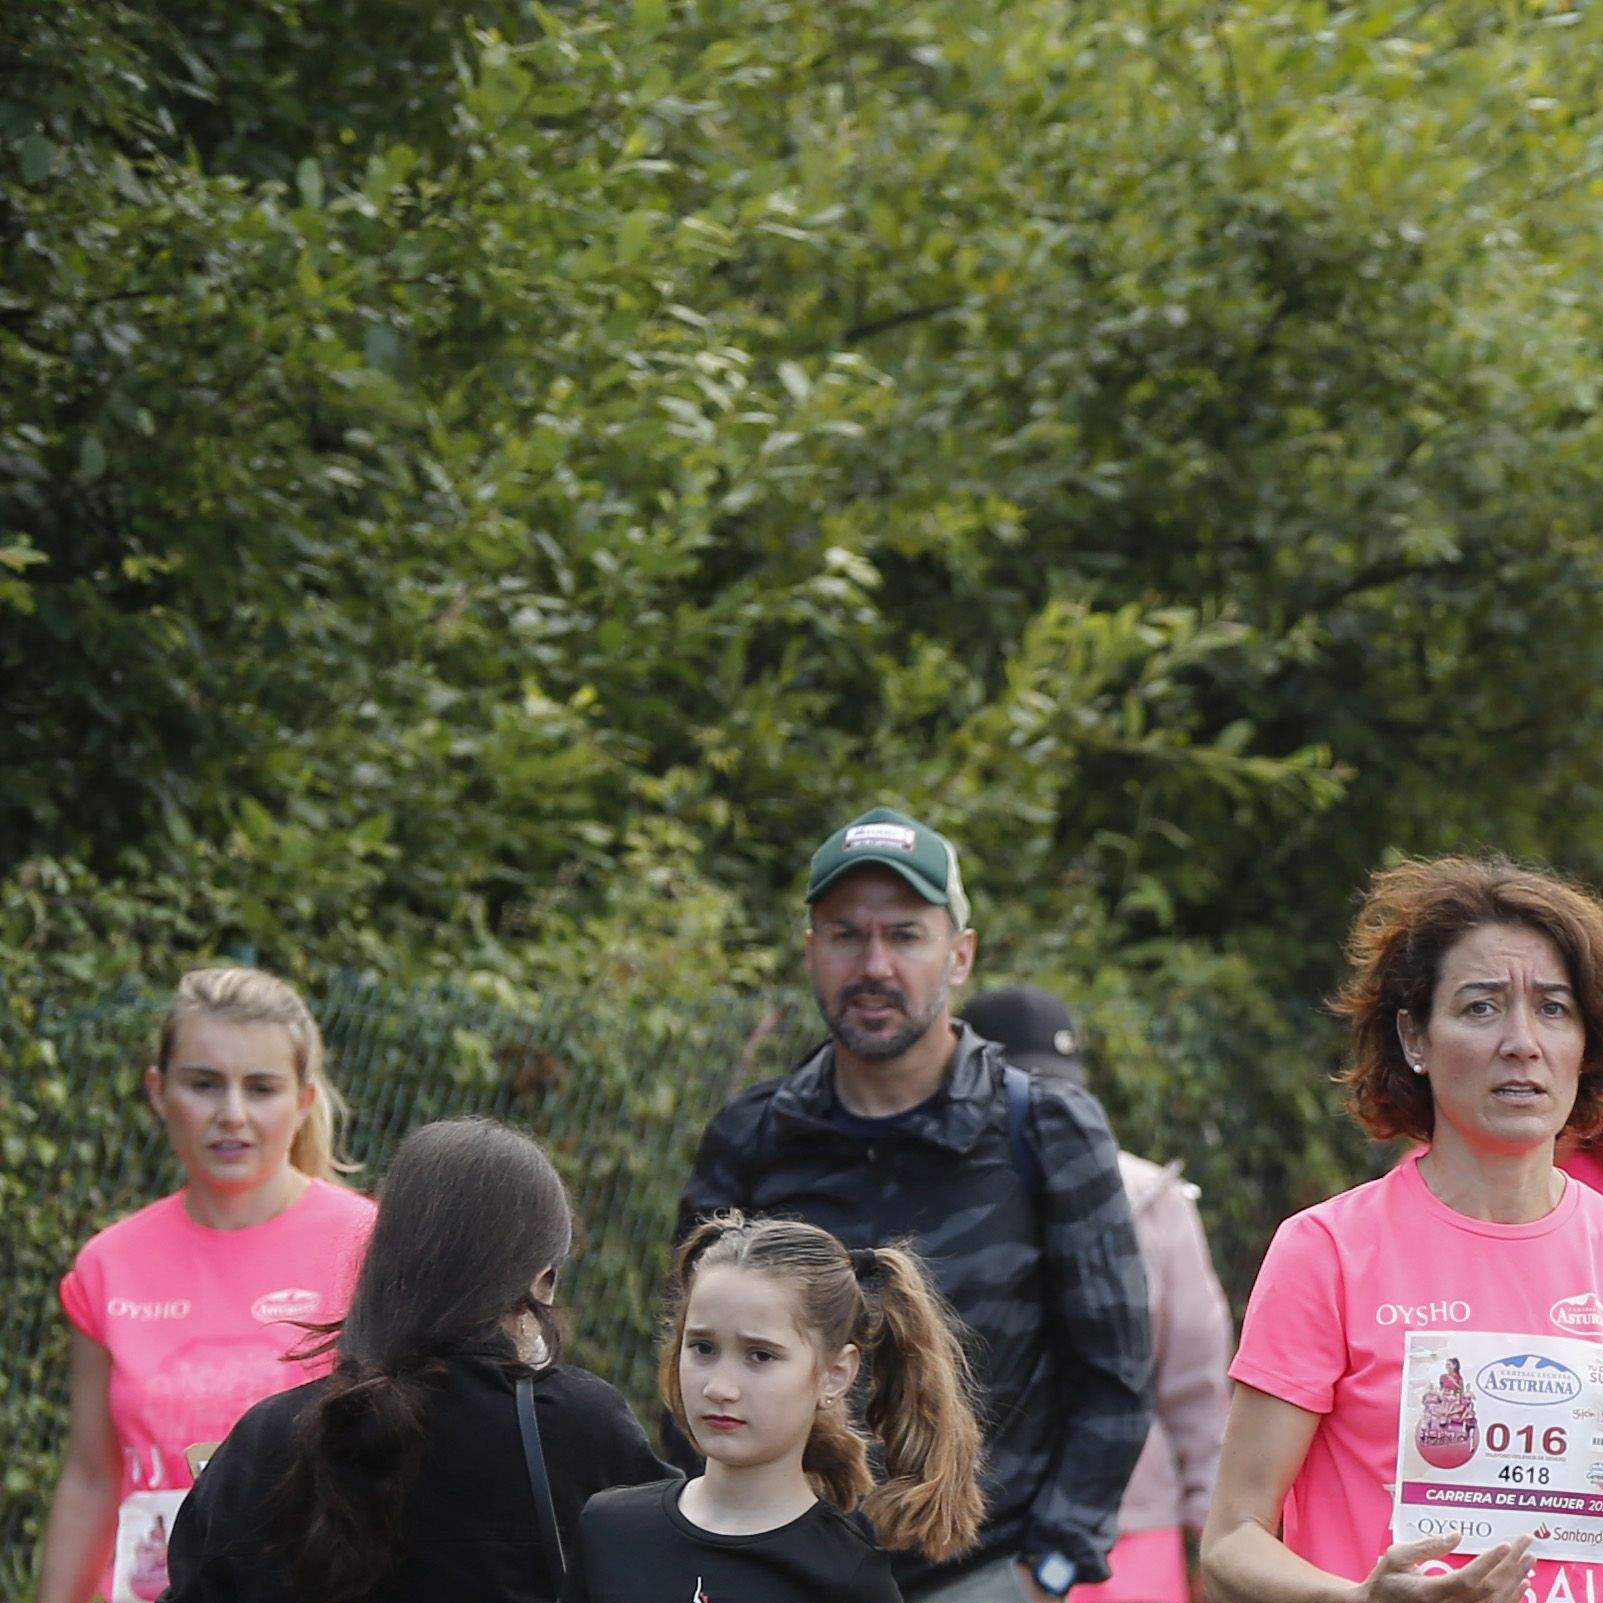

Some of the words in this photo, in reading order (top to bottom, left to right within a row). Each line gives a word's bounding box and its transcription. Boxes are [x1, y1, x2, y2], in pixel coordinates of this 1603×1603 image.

[1376, 1301, 1471, 1326] OYSHO
[1485, 1370, 1574, 1395] ASTURIANA
[1486, 1423, 1568, 1456] 016
[1498, 1465, 1550, 1485] 4618
[1425, 1489, 1492, 1505] CARRERA
[1495, 1493, 1517, 1506] DE
[1518, 1495, 1537, 1507] LA
[1539, 1496, 1585, 1510] MUJER
[1418, 1518, 1493, 1538] OYSHO
